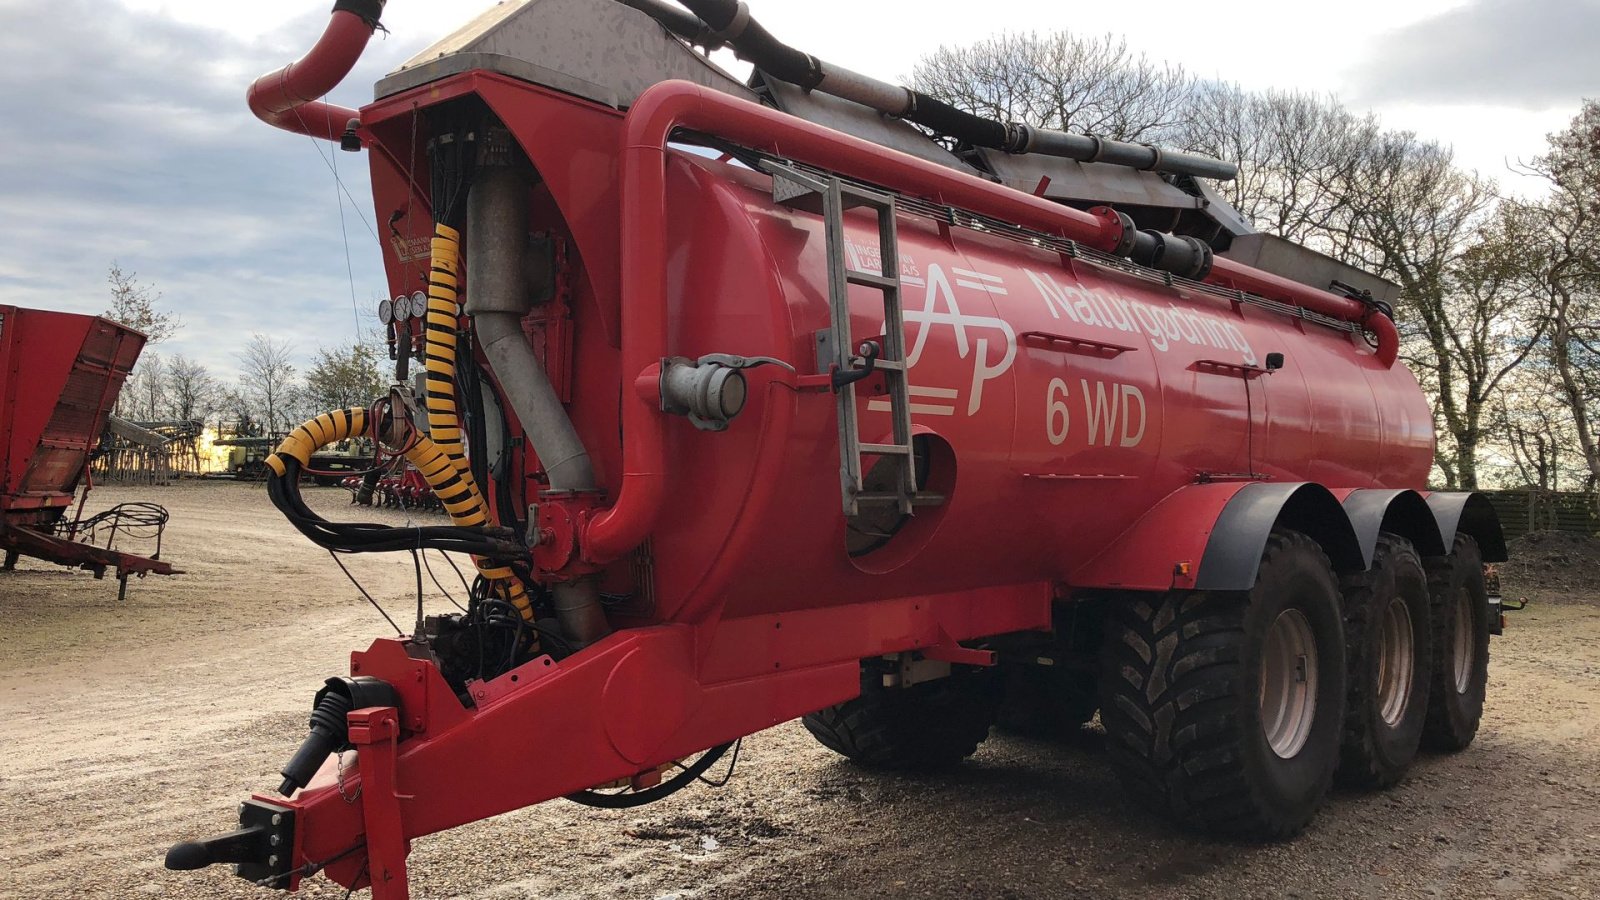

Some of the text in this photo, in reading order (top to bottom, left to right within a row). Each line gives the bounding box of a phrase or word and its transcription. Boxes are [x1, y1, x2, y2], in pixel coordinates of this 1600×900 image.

[855, 244, 915, 265] INGENN
[902, 264, 920, 276] A/S
[1023, 267, 1258, 366] Naturgødning
[1046, 377, 1146, 448] 6 WD
